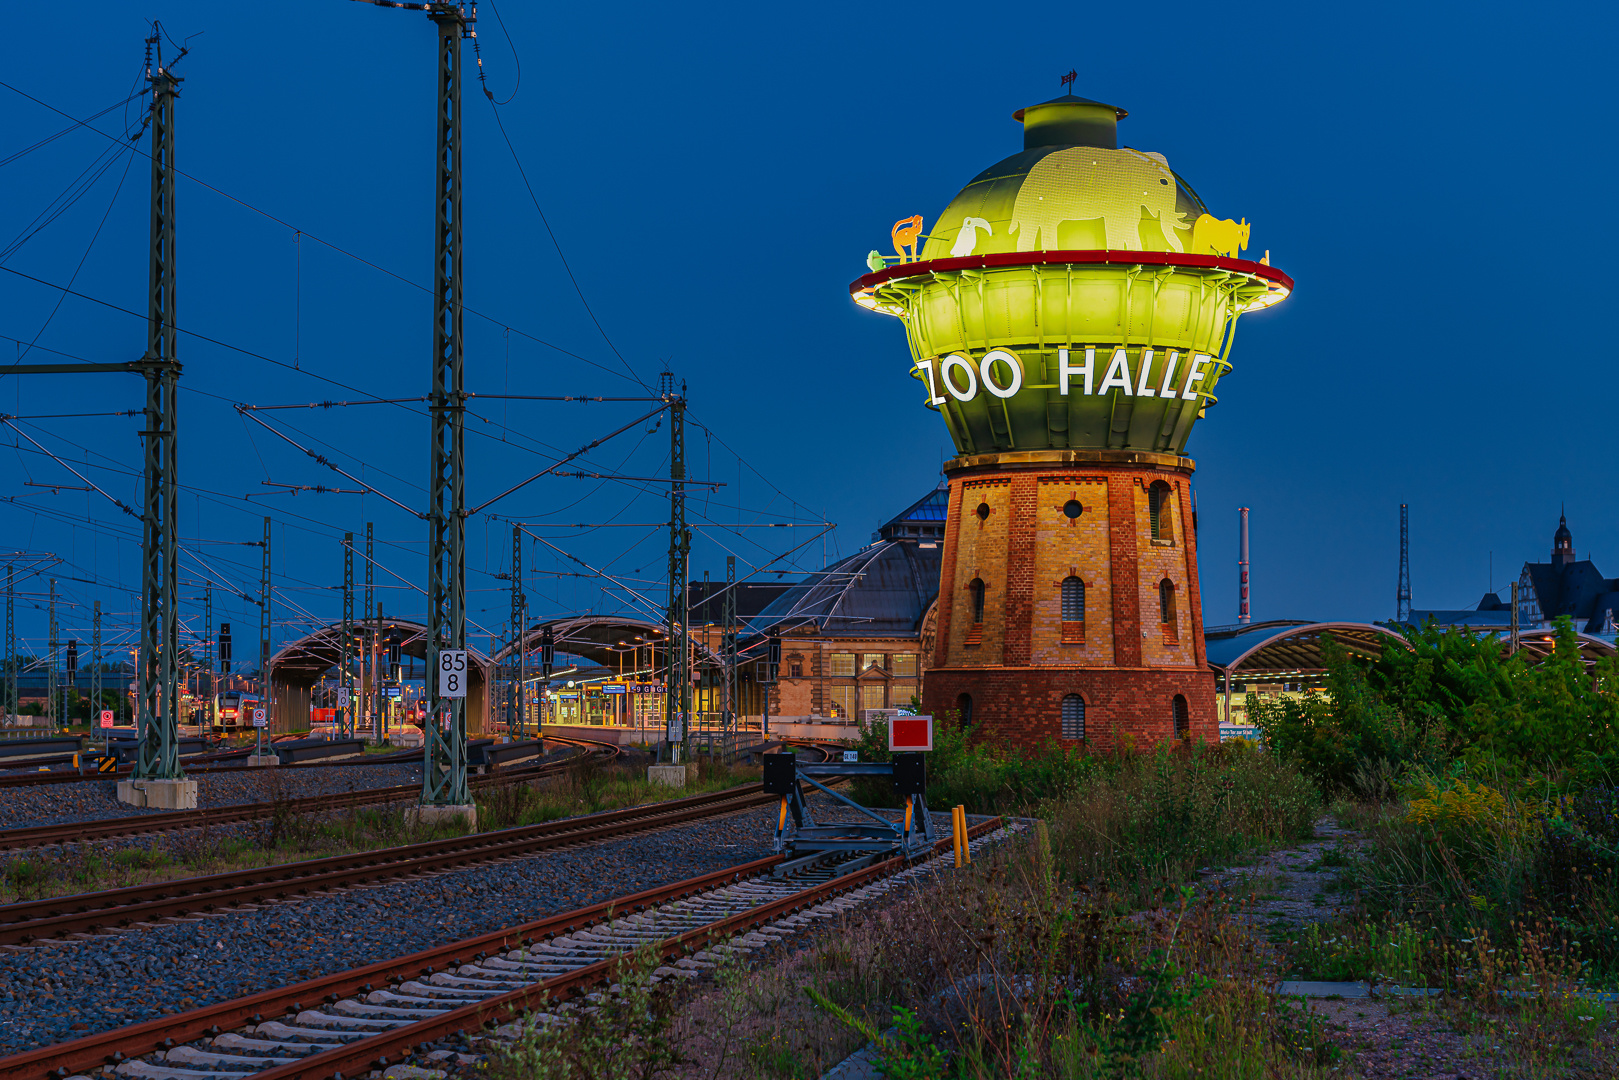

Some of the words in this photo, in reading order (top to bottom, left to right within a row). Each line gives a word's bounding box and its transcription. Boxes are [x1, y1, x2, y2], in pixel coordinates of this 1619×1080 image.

[916, 348, 1025, 406] ZOO
[1058, 346, 1212, 401] HALLE
[442, 653, 465, 671] 85
[447, 673, 459, 692] 8
[340, 696, 347, 705] 0
